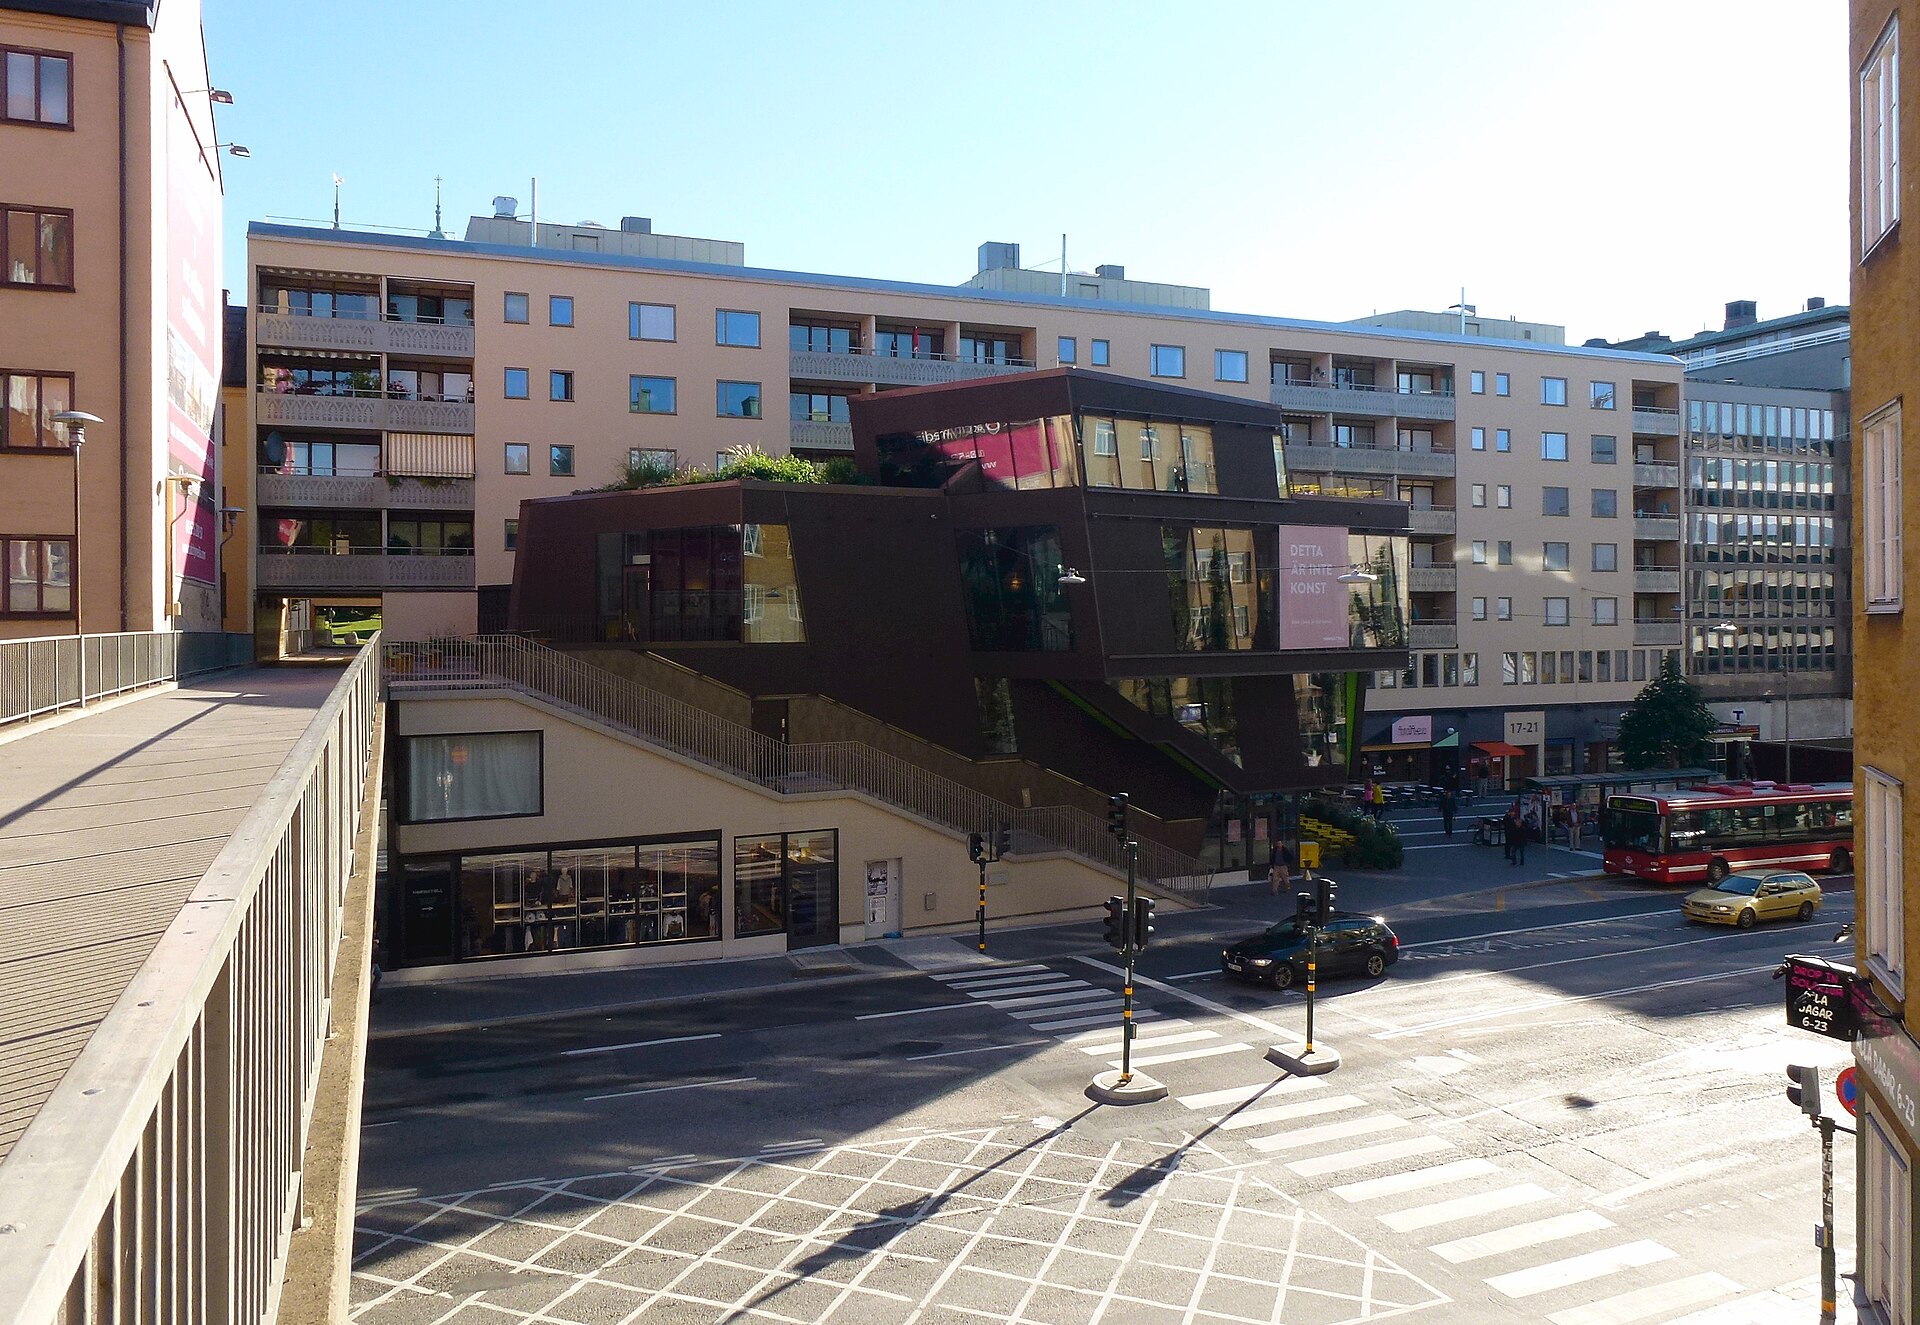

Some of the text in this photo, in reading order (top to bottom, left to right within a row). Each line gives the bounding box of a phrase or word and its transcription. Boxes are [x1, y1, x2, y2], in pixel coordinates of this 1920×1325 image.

[1290, 544, 1324, 557] DETTA
[1291, 560, 1333, 576] ÄR INTE
[1290, 582, 1327, 594] KONST
[1732, 710, 1744, 721] T
[1510, 722, 1538, 733] 17-21
[1794, 964, 1839, 983] DROP IN
[1802, 1016, 1828, 1032] 6-23
[1856, 1029, 1873, 1068] ALLA
[1873, 1050, 1895, 1100] DAGAR
[1897, 1083, 1915, 1127] 6-23
